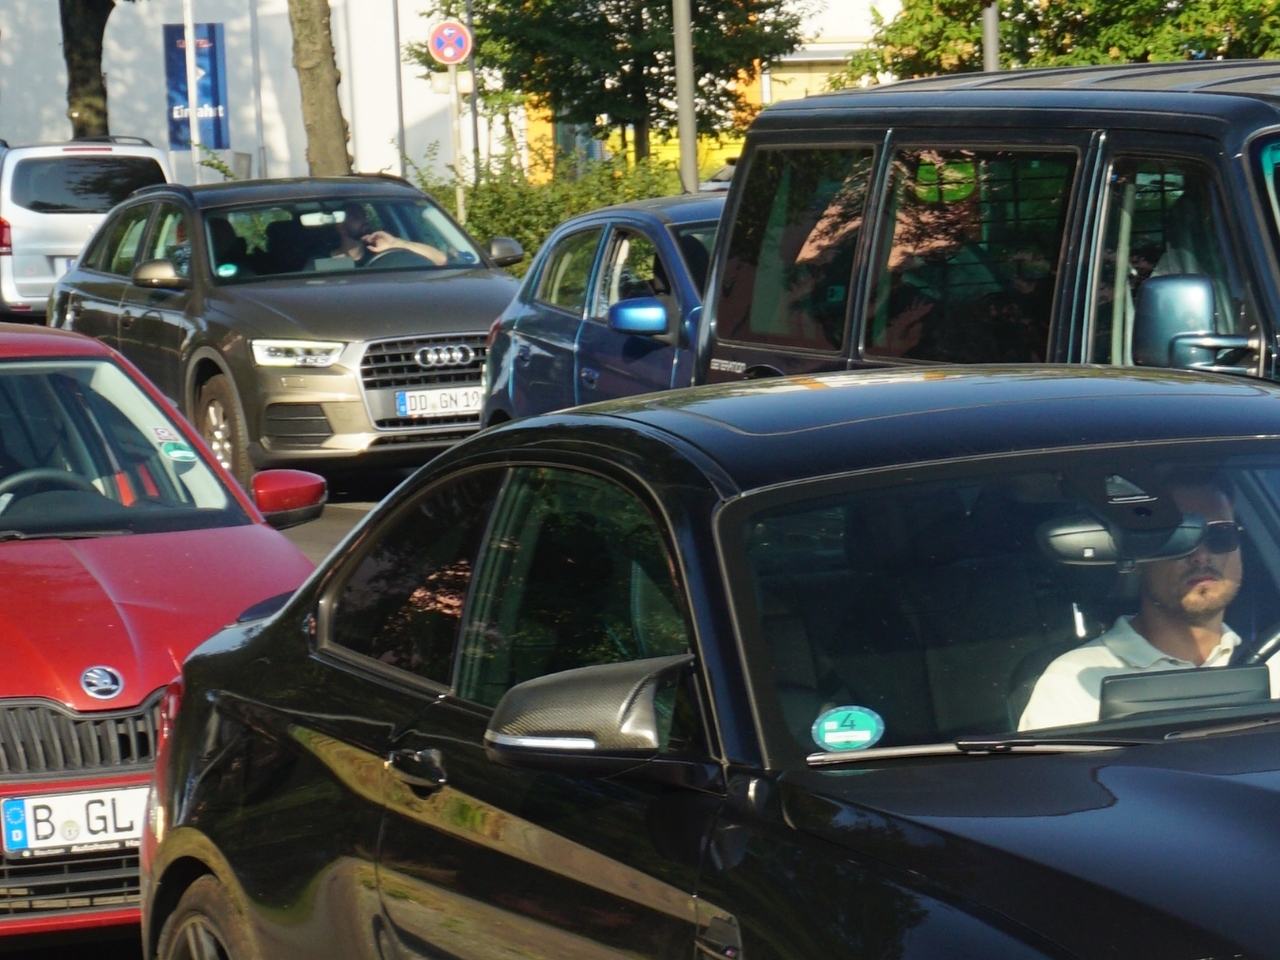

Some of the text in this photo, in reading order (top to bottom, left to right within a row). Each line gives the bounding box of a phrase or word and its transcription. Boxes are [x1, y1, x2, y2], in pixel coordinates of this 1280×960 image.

[173, 103, 225, 119] Einahrt
[408, 394, 428, 412] DD
[439, 392, 459, 409] GN
[839, 712, 857, 730] 4
[32, 797, 134, 841] B GL
